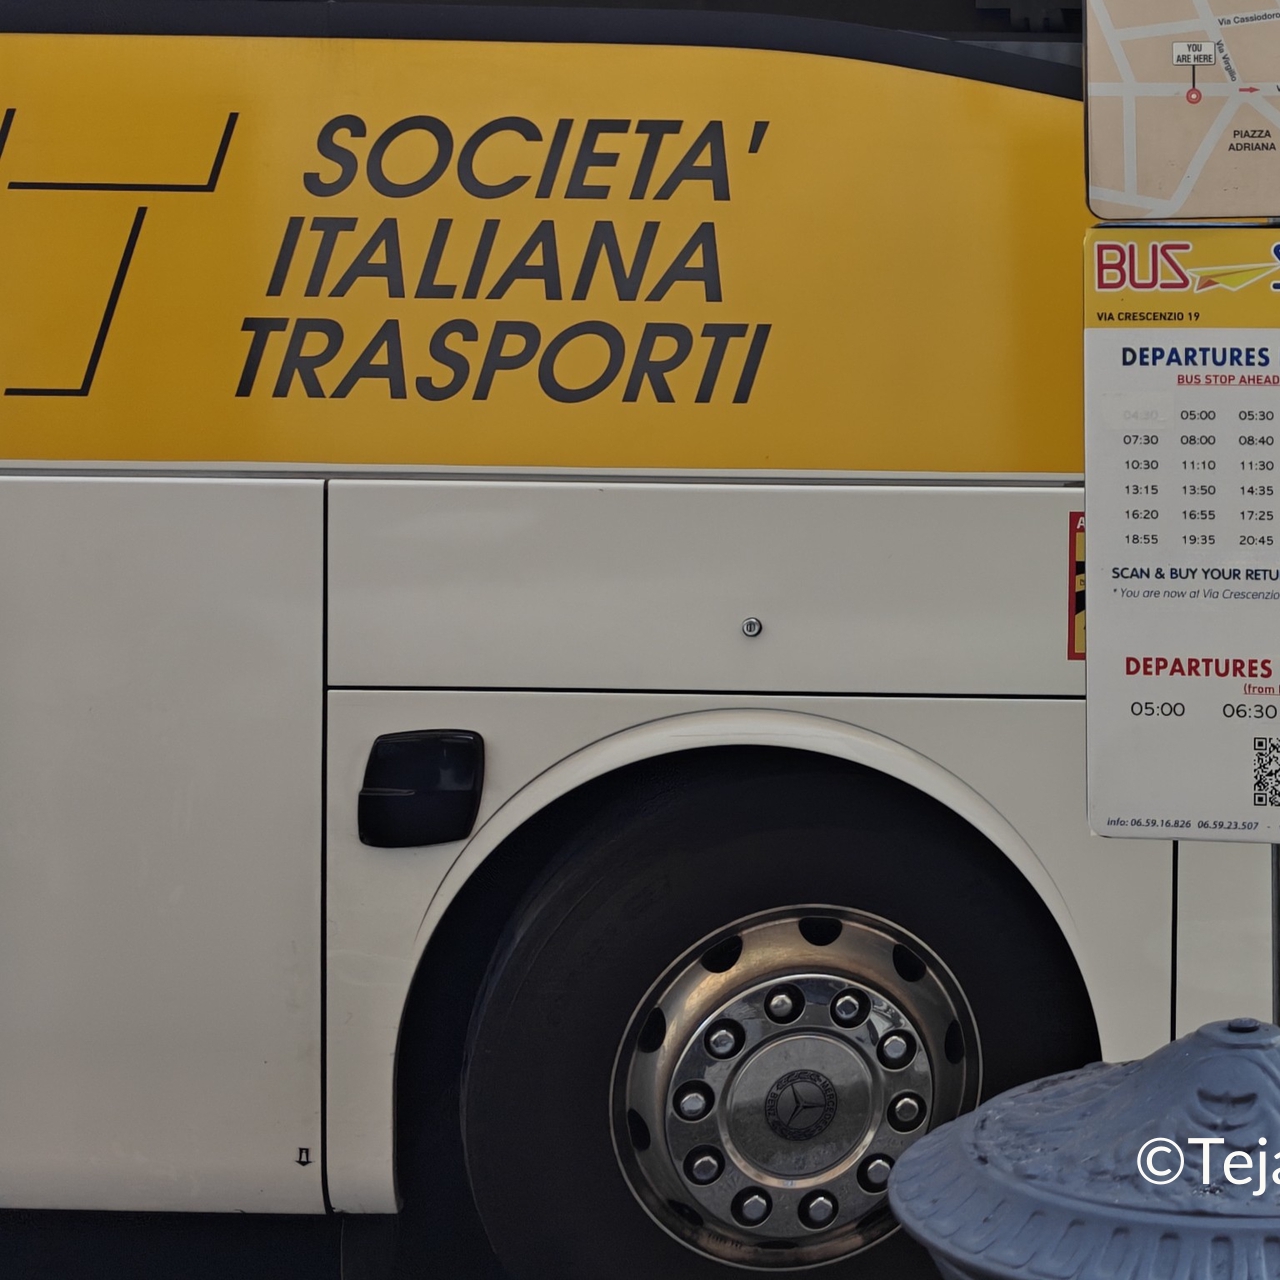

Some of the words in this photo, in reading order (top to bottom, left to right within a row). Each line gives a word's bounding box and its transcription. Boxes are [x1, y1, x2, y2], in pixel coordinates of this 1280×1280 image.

[1218, 18, 1231, 26] Via
[1233, 12, 1280, 24] Cassiodoro
[1187, 44, 1202, 52] YOU
[1176, 54, 1191, 63] ARE
[1193, 55, 1213, 63] HERE
[1216, 40, 1224, 53] Via
[1222, 54, 1236, 81] Virgilio
[1234, 130, 1271, 138] PIAZZA
[1228, 143, 1276, 151] ADRIANA
[303, 114, 769, 201] SOCIETA'
[266, 217, 722, 302] ITALIANA
[1095, 241, 1192, 293] BUS
[1097, 313, 1114, 321] VIA
[1118, 312, 1184, 321] CRESCENZIO
[1189, 312, 1199, 321] 19
[235, 317, 772, 403] TRASPORTI
[1123, 347, 1269, 366] DEPARTURES
[1177, 375, 1202, 384] BUS
[1205, 375, 1235, 385] STOP
[1240, 375, 1280, 385] AHEAD
[1181, 411, 1216, 420] 05:00
[1239, 411, 1274, 420] 05:30
[1123, 435, 1158, 445] 07:30
[1181, 435, 1215, 445] 08:00
[1239, 436, 1274, 445] 08:40
[1126, 460, 1158, 469] 10:30
[1183, 460, 1216, 470] 11:10
[1241, 461, 1274, 470] 11:30
[1125, 485, 1158, 494] 13:15
[1183, 485, 1216, 495] 13:50
[1241, 486, 1273, 495] 14:35
[1126, 510, 1158, 519] 16:20
[1183, 510, 1215, 520] 16:55
[1241, 511, 1273, 520] 17:25
[1126, 535, 1158, 544] 18:55
[1183, 535, 1215, 544] 19:35
[1240, 536, 1273, 545] 20:45
[1112, 568, 1150, 579] SCAN
[1155, 568, 1165, 579] &
[1170, 568, 1197, 579] BUY
[1202, 569, 1240, 580] YOUR
[1121, 588, 1140, 598] You
[1143, 590, 1160, 598] are
[1190, 590, 1200, 598] at
[1203, 589, 1219, 598] Via
[1222, 589, 1280, 599] Crescenzio
[1126, 657, 1272, 678] DEPARTURES
[1244, 684, 1274, 695] (from
[1131, 702, 1185, 716] 05:00
[1223, 704, 1277, 719] 06:30
[1107, 818, 1128, 826] info:
[1131, 819, 1191, 828] 06.59.16.826
[1198, 821, 1258, 830] 06.59.23.507
